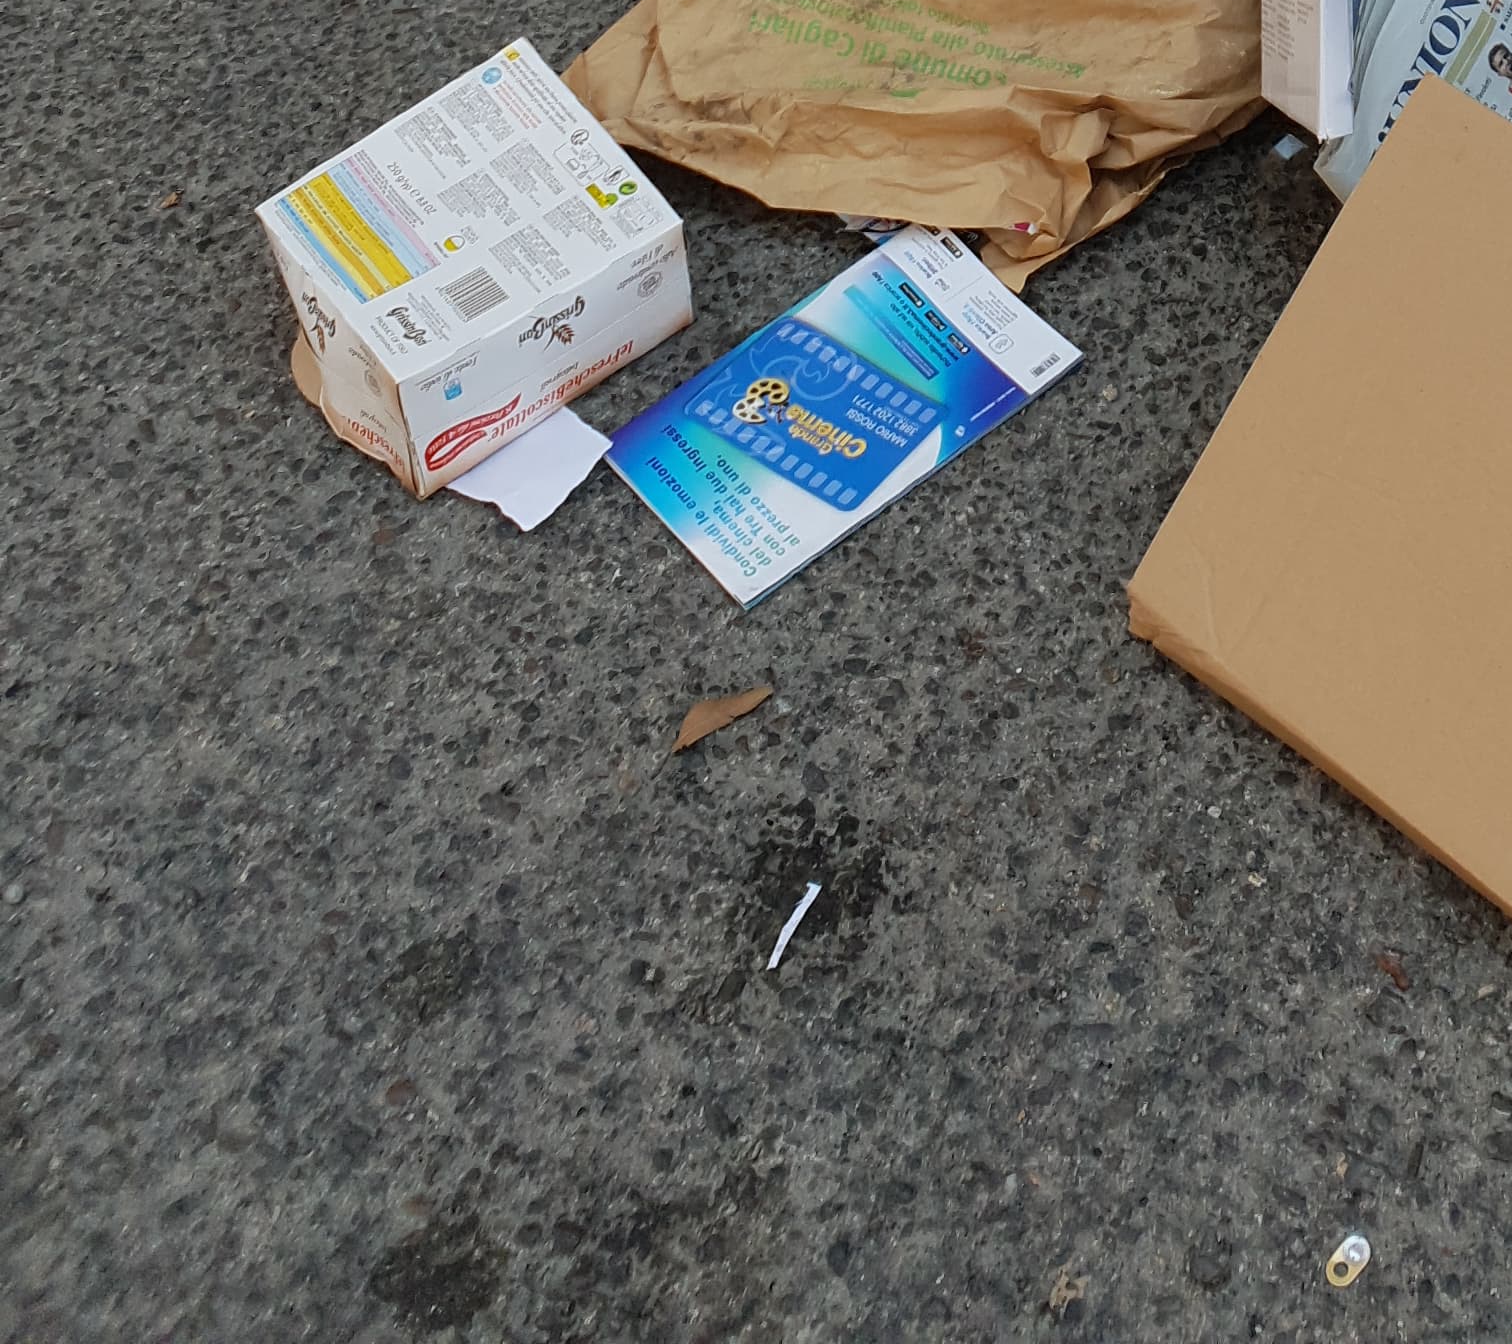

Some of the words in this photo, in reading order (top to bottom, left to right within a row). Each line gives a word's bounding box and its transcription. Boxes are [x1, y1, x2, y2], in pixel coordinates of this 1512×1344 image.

[748, 10, 856, 60] Cagliari
[862, 31, 886, 66] di
[784, 404, 868, 460] Cinema
[846, 408, 878, 433] ROSSI
[877, 422, 908, 447] MARIO
[662, 423, 706, 473] ingressi
[789, 423, 833, 456] Grande
[646, 455, 698, 513] emozioni
[705, 466, 729, 494] due
[717, 454, 744, 485] uno,
[694, 499, 712, 519] le
[728, 490, 749, 515] hai
[758, 495, 791, 539] prezzo
[713, 499, 753, 552] cinema,
[749, 514, 770, 538] Tre
[787, 530, 802, 547] al
[708, 518, 758, 579] Condividi
[751, 541, 774, 568] del
[765, 532, 787, 559] con
